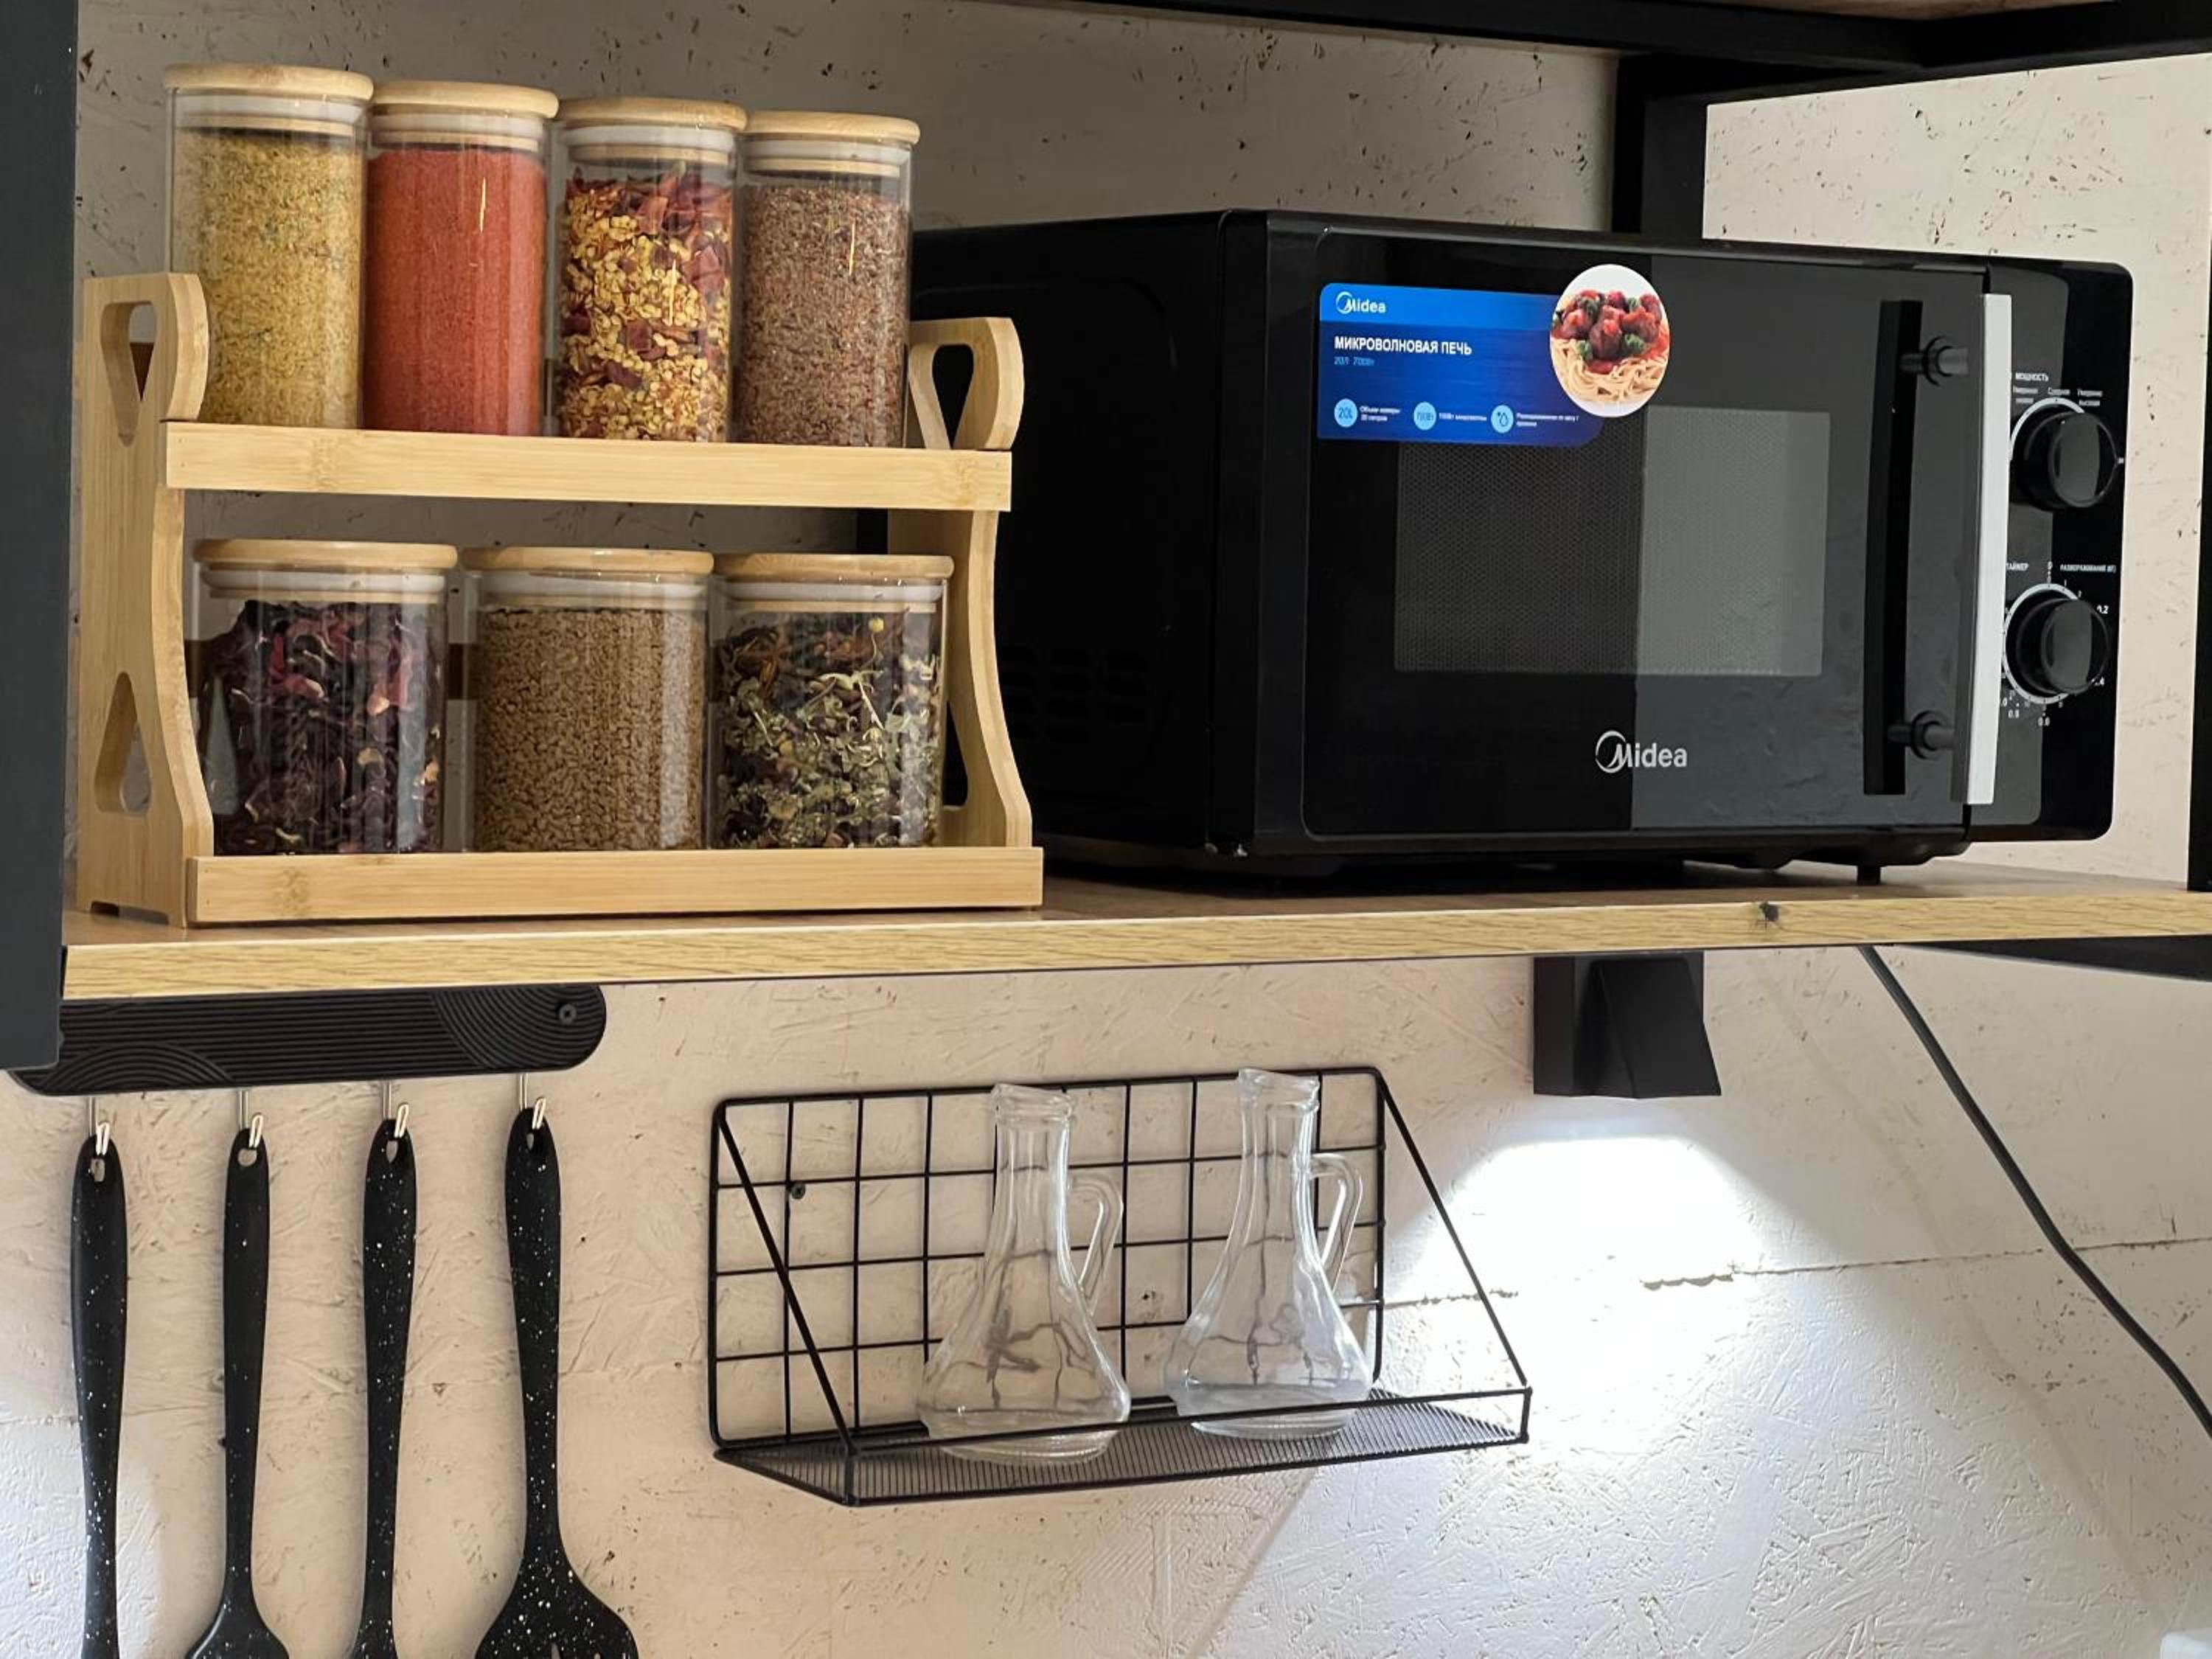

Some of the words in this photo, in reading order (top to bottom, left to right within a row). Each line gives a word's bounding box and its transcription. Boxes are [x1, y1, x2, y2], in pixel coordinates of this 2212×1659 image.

[1335, 291, 1386, 314] Midea
[1334, 335, 1439, 354] МИКРОВОЛНОВАЯ
[1440, 341, 1473, 355] ПЕЧЬ
[1595, 730, 1688, 773] Midea
